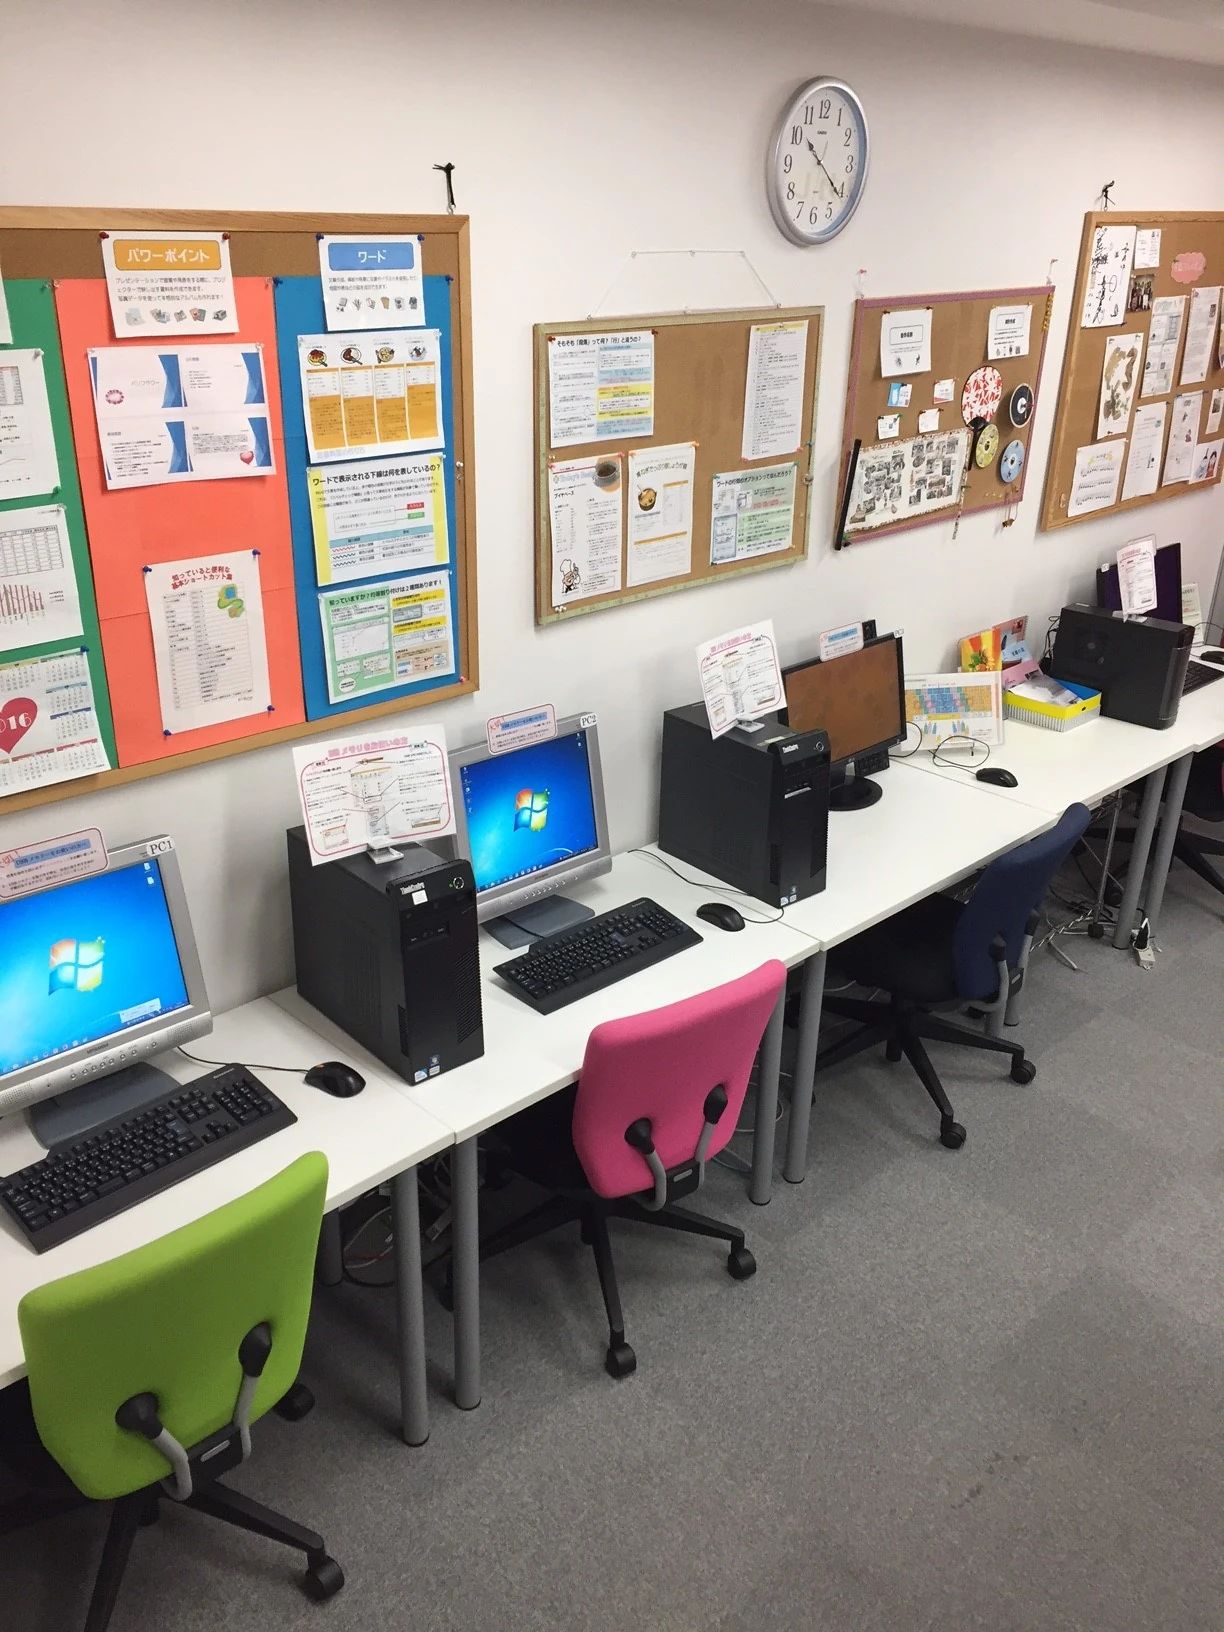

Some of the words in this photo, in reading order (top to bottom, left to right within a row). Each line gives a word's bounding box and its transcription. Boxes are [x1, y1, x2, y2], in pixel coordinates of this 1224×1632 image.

[804, 105, 814, 125] 11
[818, 99, 831, 119] 12
[837, 107, 842, 127] 1
[790, 125, 803, 145] 10
[844, 127, 852, 147] 2
[784, 154, 792, 174] 9
[845, 154, 854, 173] 3
[787, 181, 795, 200] 8
[838, 181, 845, 198] 4
[796, 201, 804, 219] 7
[809, 206, 818, 225] 6
[825, 202, 833, 219] 5
[127, 248, 210, 263] パワーポイント
[358, 249, 387, 263] ワード
[312, 464, 441, 486] ワードで表示される下線は何を表しているの？
[581, 715, 597, 726] PC2
[150, 840, 174, 855] PC1
